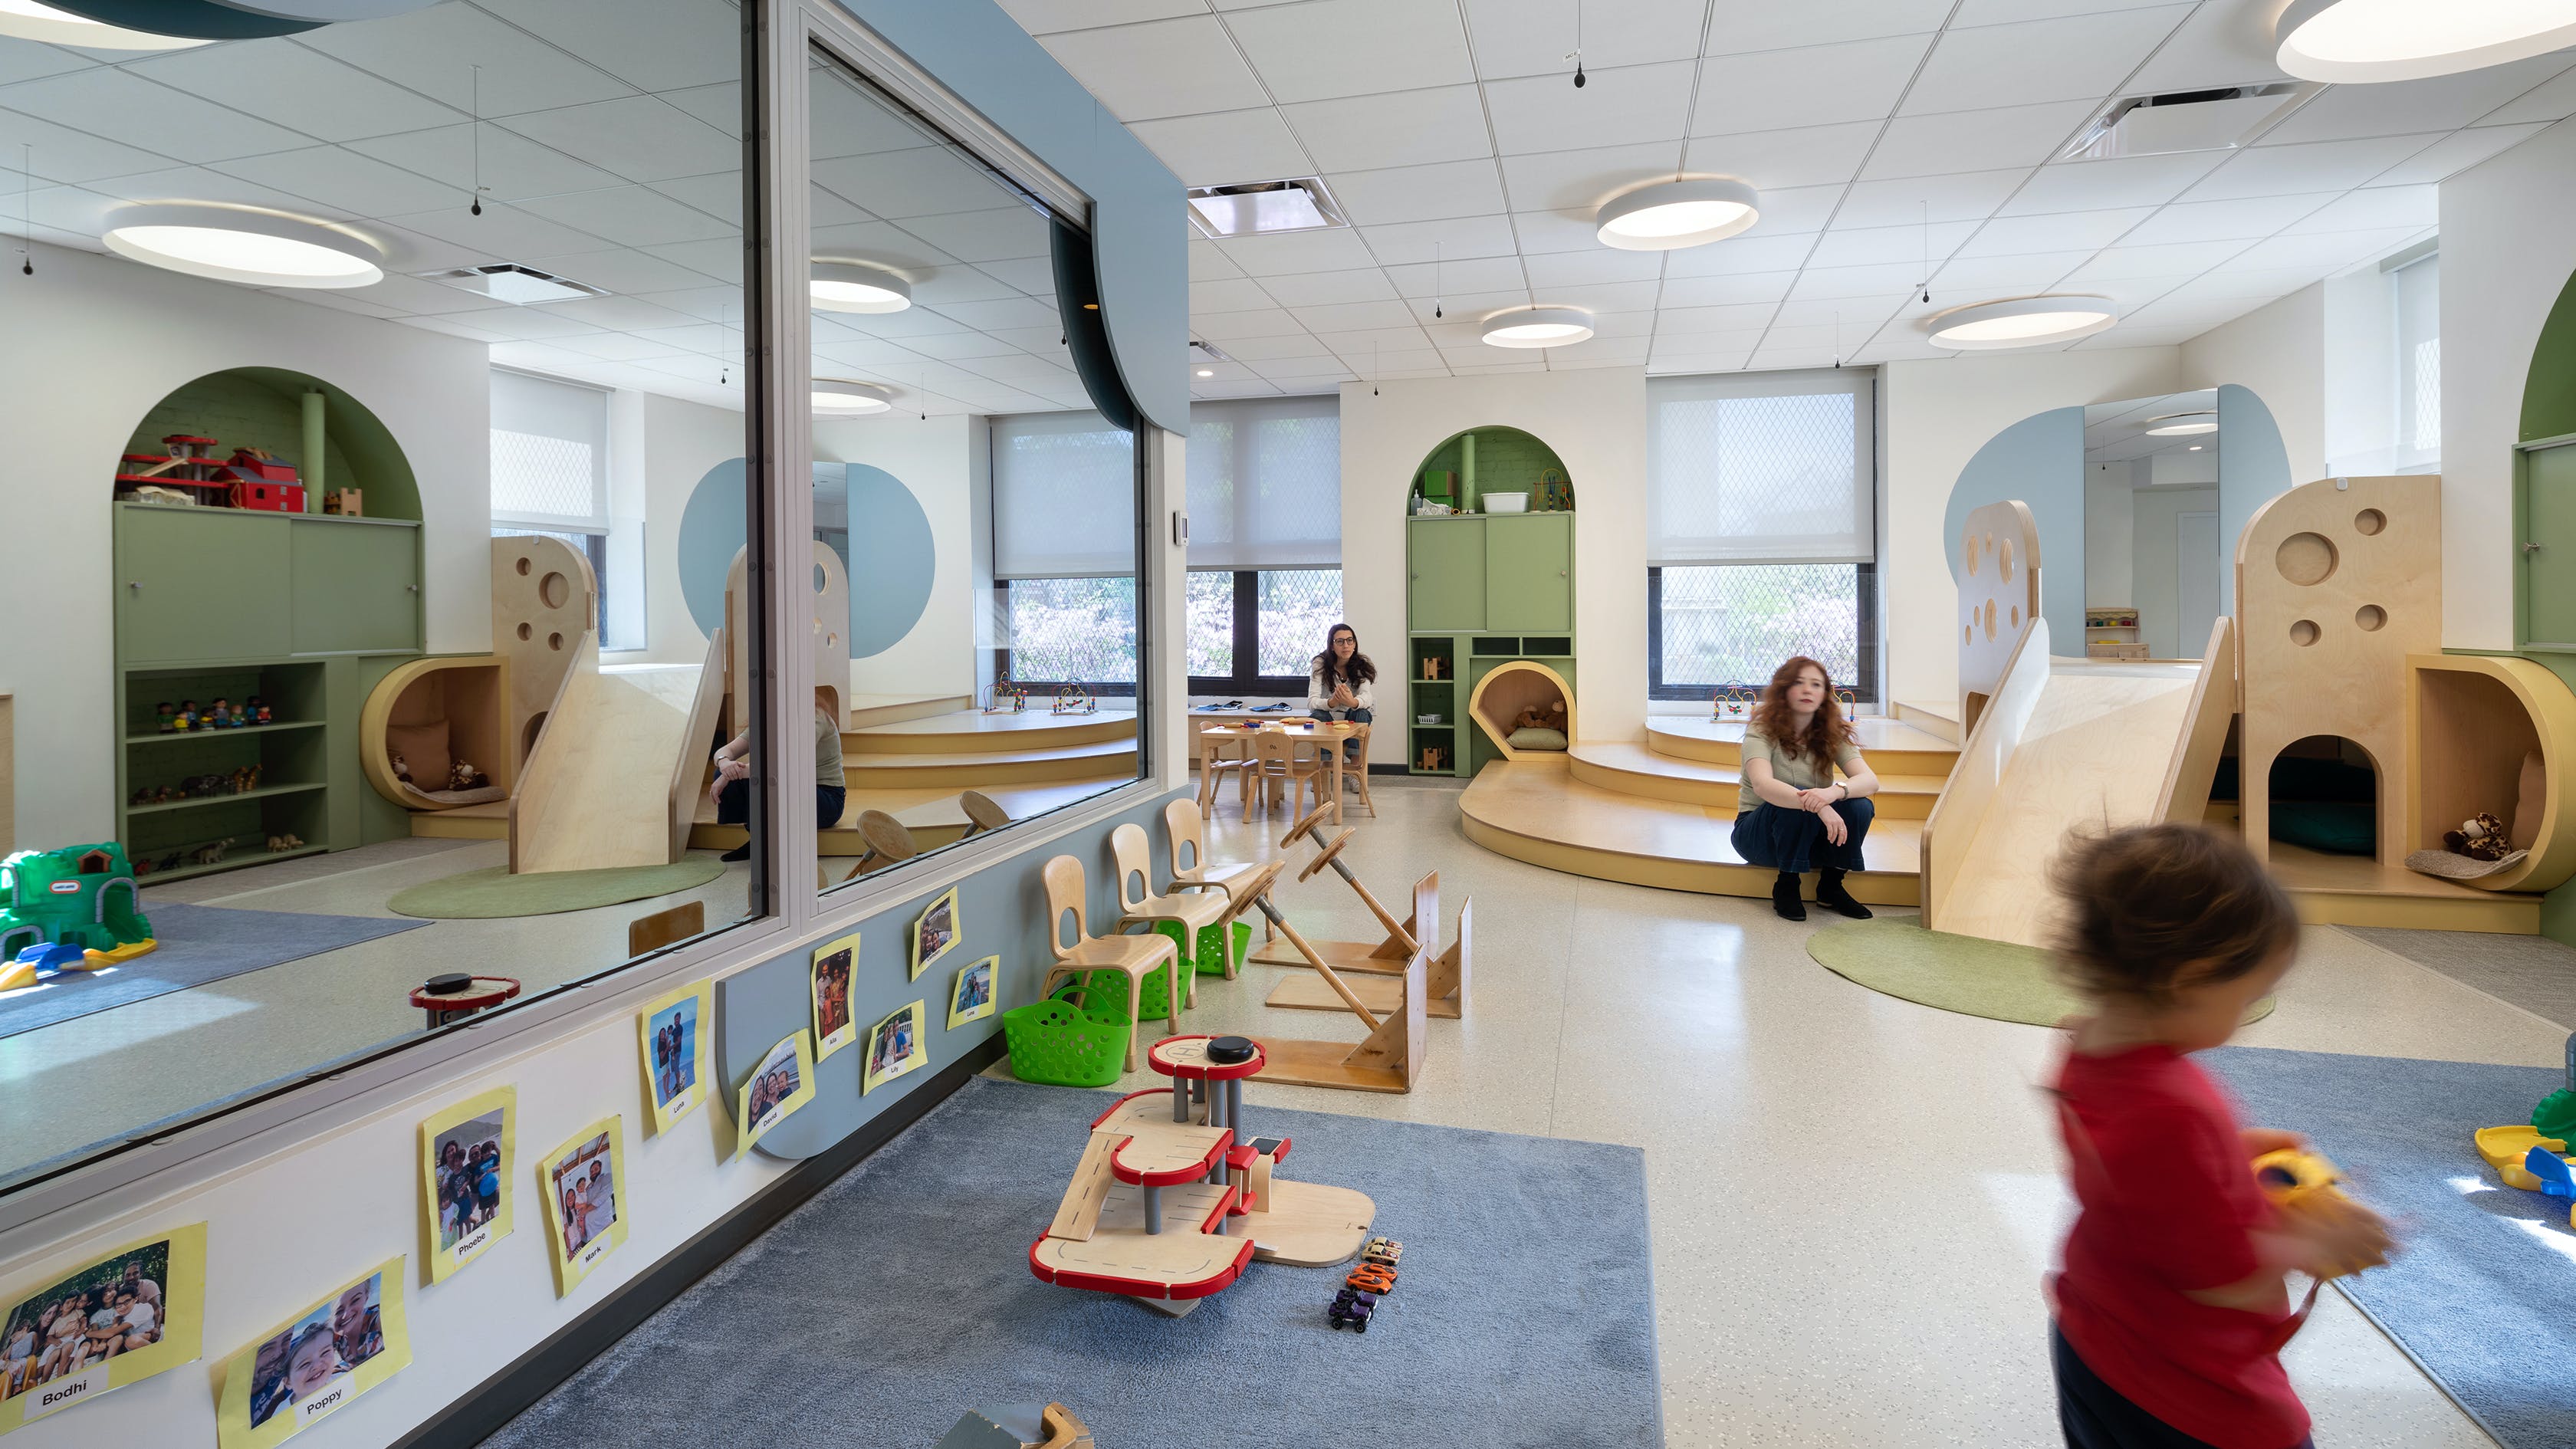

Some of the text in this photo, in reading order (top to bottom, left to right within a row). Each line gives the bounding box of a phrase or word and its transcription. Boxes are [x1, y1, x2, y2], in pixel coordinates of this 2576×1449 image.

[1172, 1046, 1200, 1056] H
[763, 1112, 777, 1127] David
[458, 1233, 486, 1255] Phoebe
[585, 1246, 601, 1263] Mark
[42, 1379, 87, 1406] Bodhi
[307, 1388, 342, 1414] Poppy
